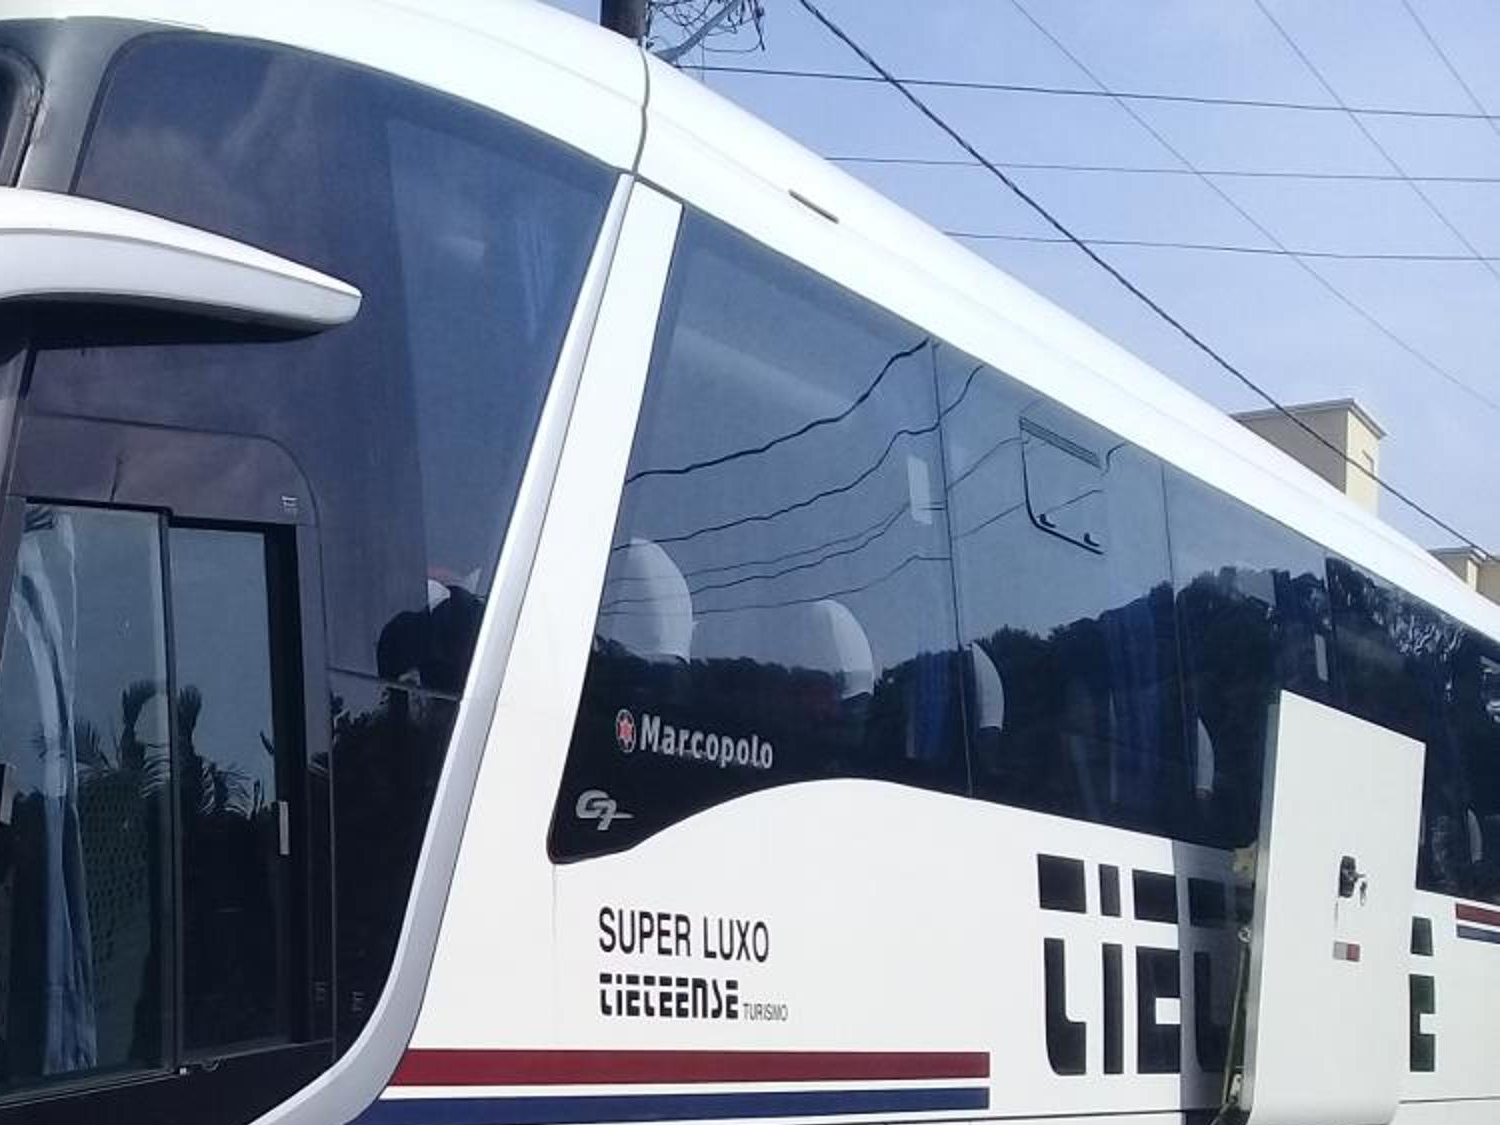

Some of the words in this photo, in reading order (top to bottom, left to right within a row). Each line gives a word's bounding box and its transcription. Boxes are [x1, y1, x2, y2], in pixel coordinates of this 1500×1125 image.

[640, 712, 773, 769] Marcopolo
[599, 906, 692, 957] SUPER
[703, 916, 770, 962] LUXO
[743, 1003, 789, 1022] TURISMO
